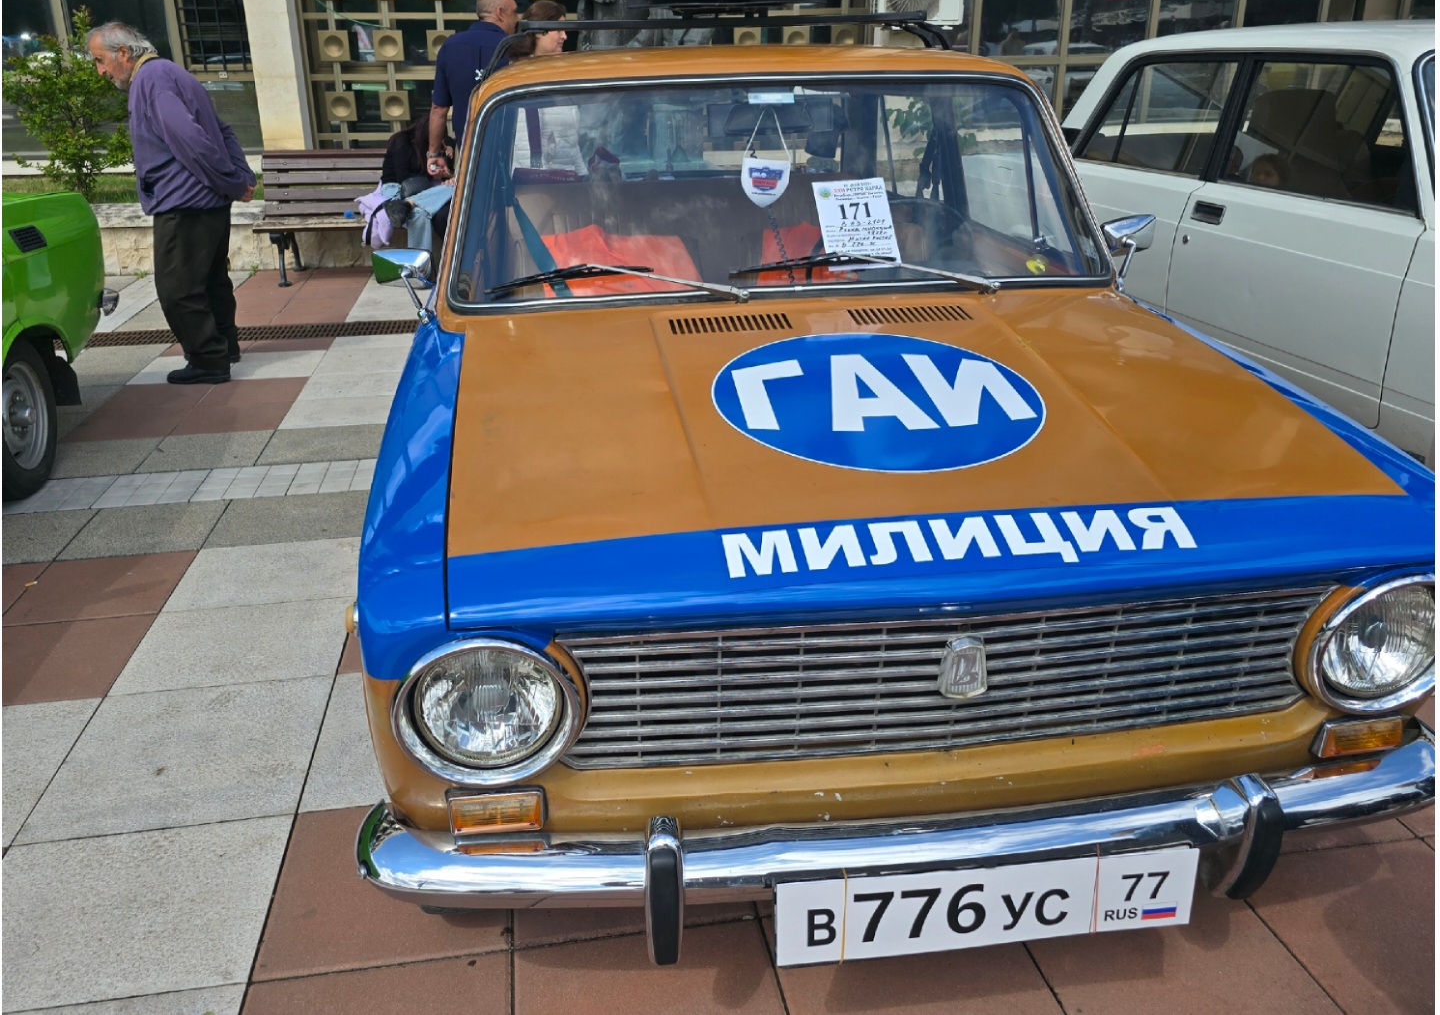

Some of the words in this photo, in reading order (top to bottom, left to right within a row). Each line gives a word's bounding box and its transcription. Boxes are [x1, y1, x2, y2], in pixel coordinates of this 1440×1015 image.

[838, 202, 872, 220] 171
[731, 353, 1038, 432] ГАИ
[721, 506, 1198, 579] МИЛИЦИЯ
[1121, 871, 1171, 902] 77
[853, 883, 987, 943] 776
[1104, 907, 1138, 922] RUS
